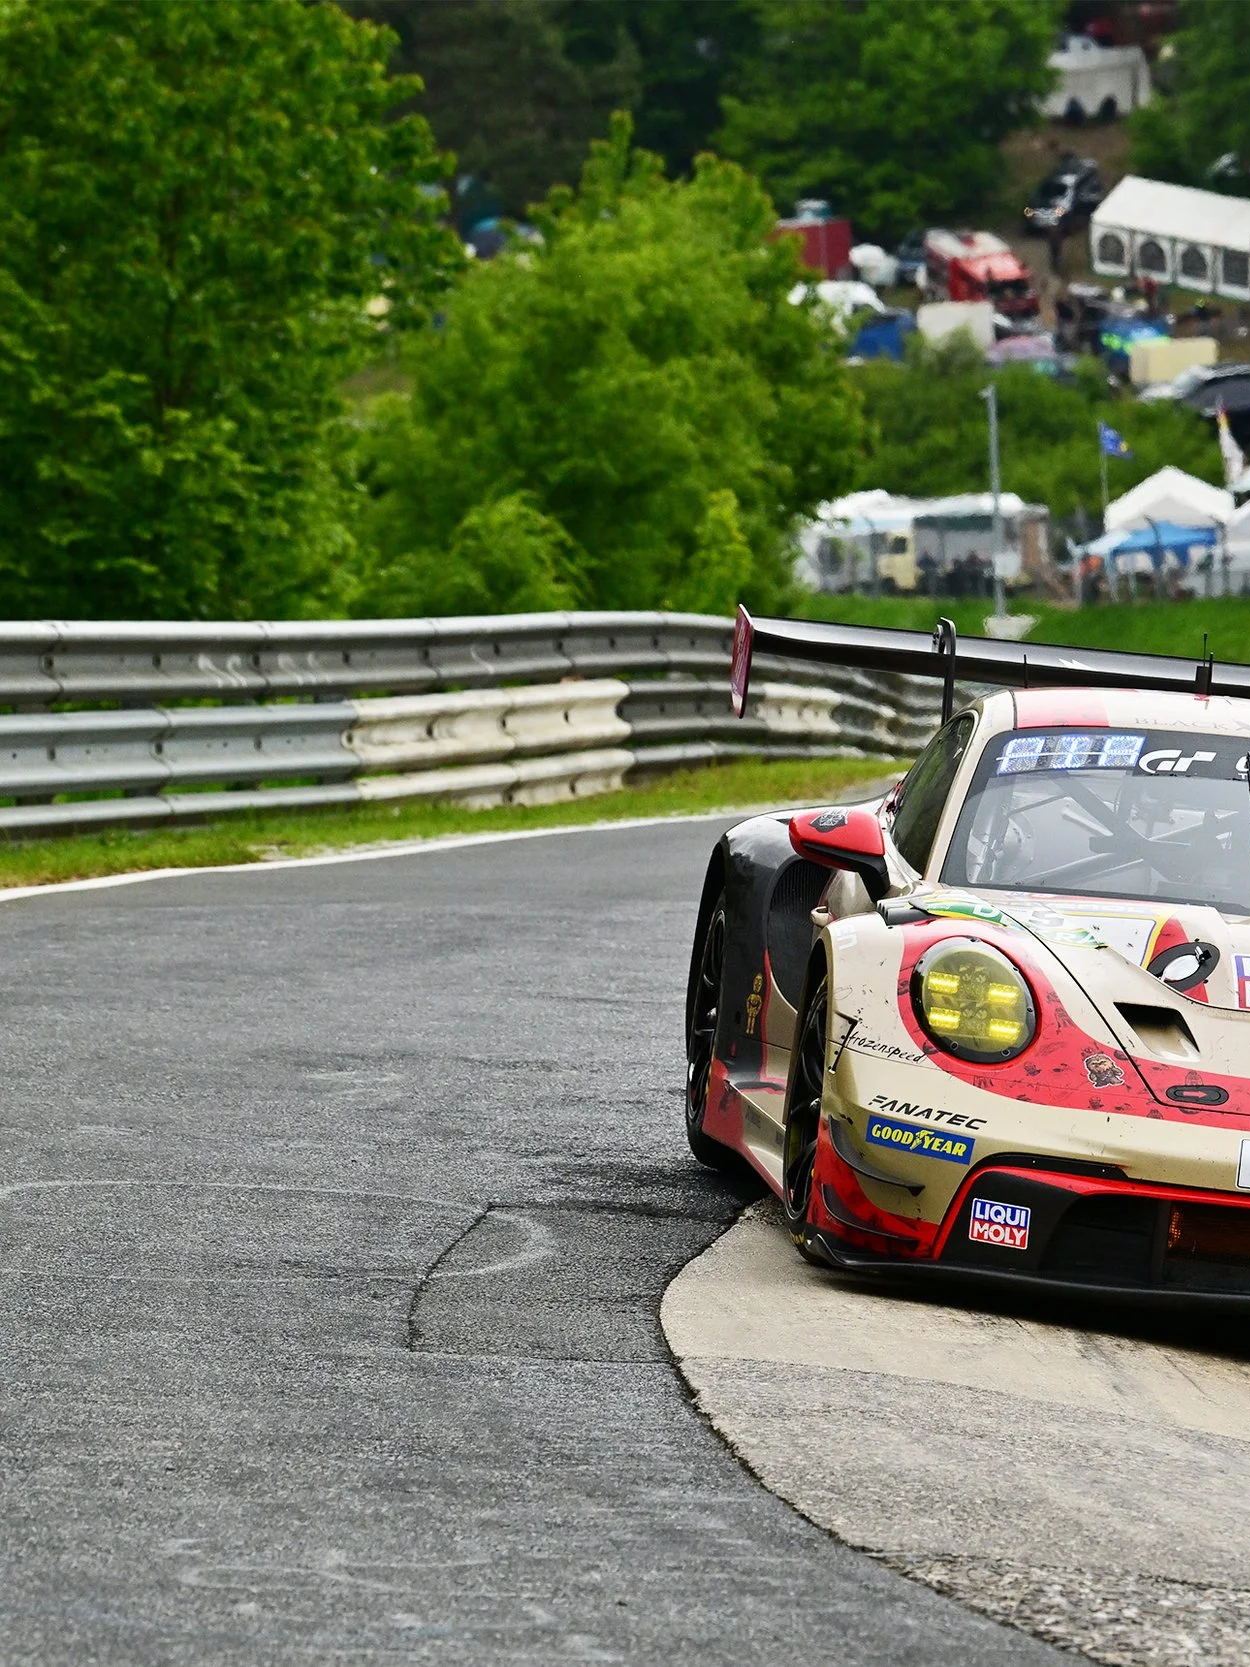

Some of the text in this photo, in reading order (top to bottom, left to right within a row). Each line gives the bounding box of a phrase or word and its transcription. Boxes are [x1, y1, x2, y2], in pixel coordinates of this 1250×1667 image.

[868, 1094, 988, 1131] FANATEC
[975, 1201, 1027, 1227] LIQUI
[973, 1220, 1027, 1246] MOLY
